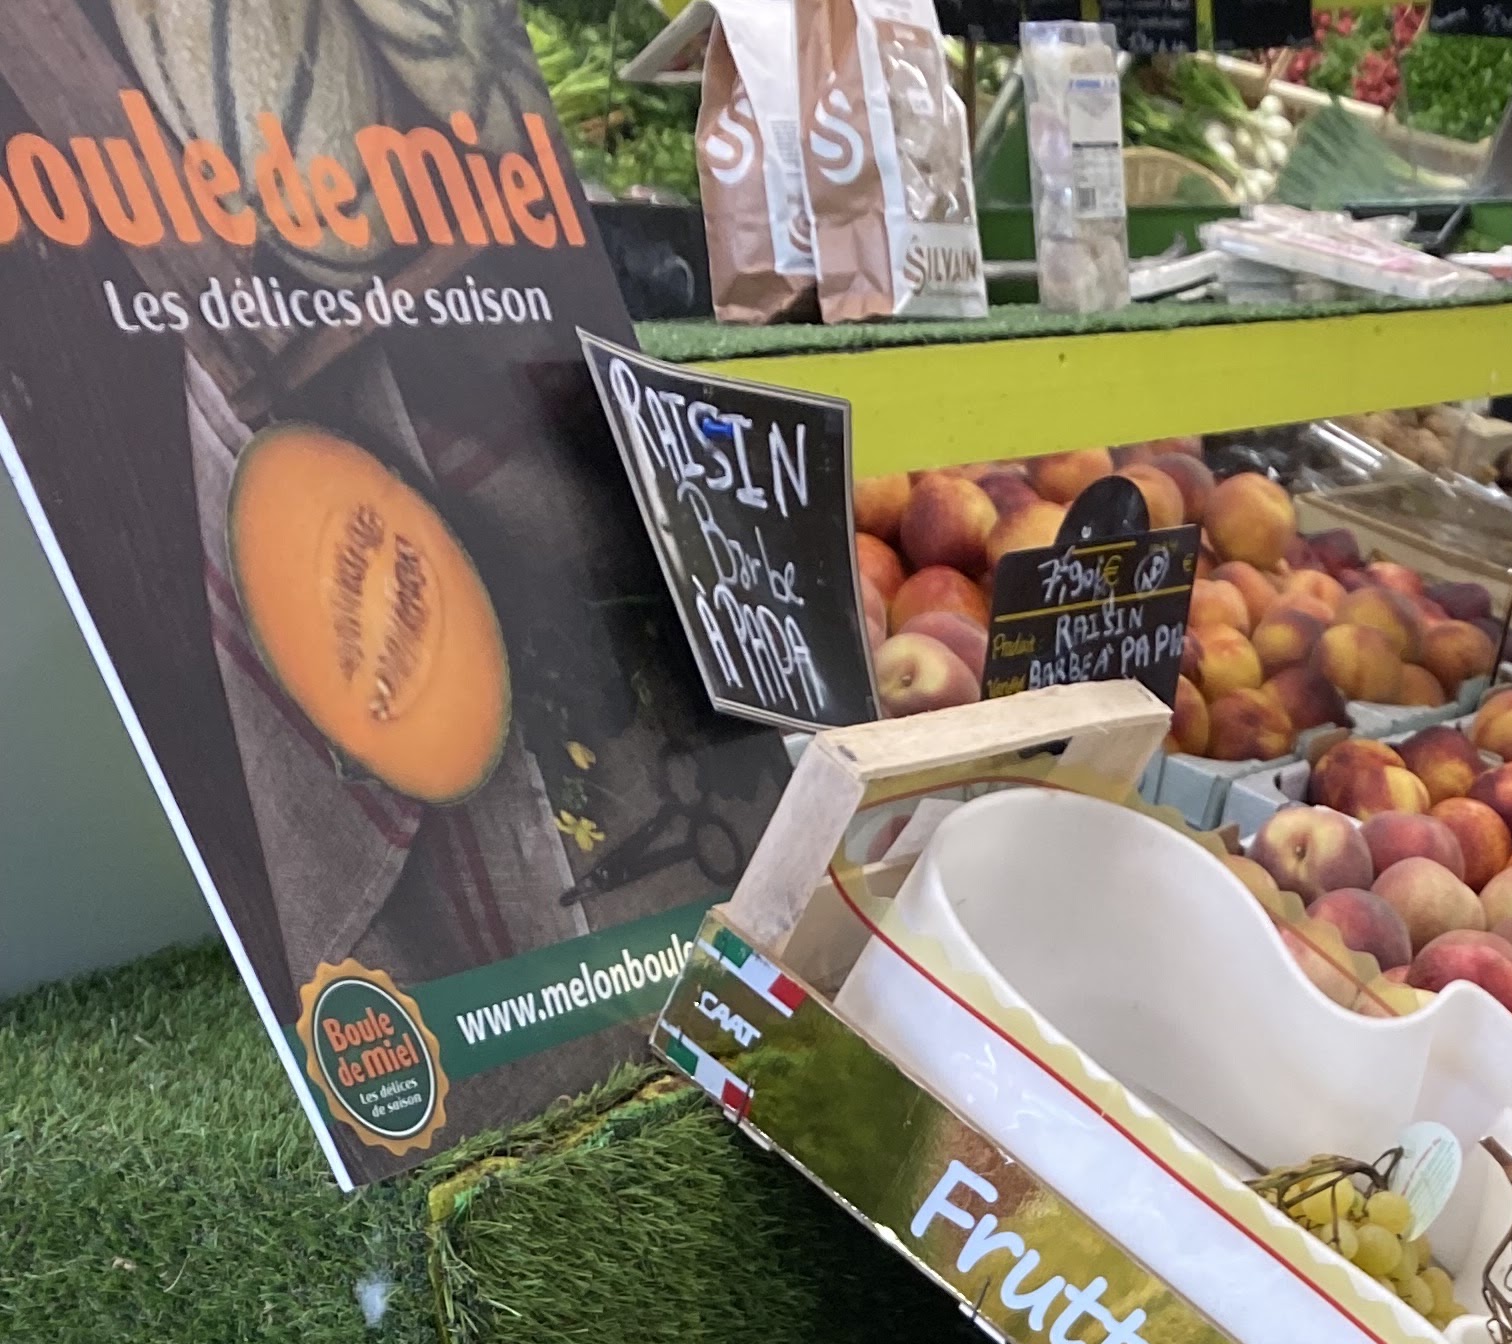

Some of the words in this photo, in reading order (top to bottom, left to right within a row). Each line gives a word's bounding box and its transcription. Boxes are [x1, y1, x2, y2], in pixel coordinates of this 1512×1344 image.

[0, 88, 257, 248] oule
[255, 110, 370, 248] de
[904, 246, 977, 296] SILVAIN
[102, 279, 191, 333] Les
[200, 276, 363, 330] délices
[364, 275, 417, 328] de
[423, 274, 553, 326] saison
[608, 357, 810, 518] RAISIN
[1055, 604, 1144, 655] RAISIN
[322, 1006, 395, 1054] Boule
[699, 990, 762, 1047] CAAT
[337, 1056, 366, 1087] de
[359, 1091, 379, 1105] Les
[379, 1077, 419, 1098] délices
[371, 1104, 386, 1118] de
[387, 1091, 423, 1113] saison
